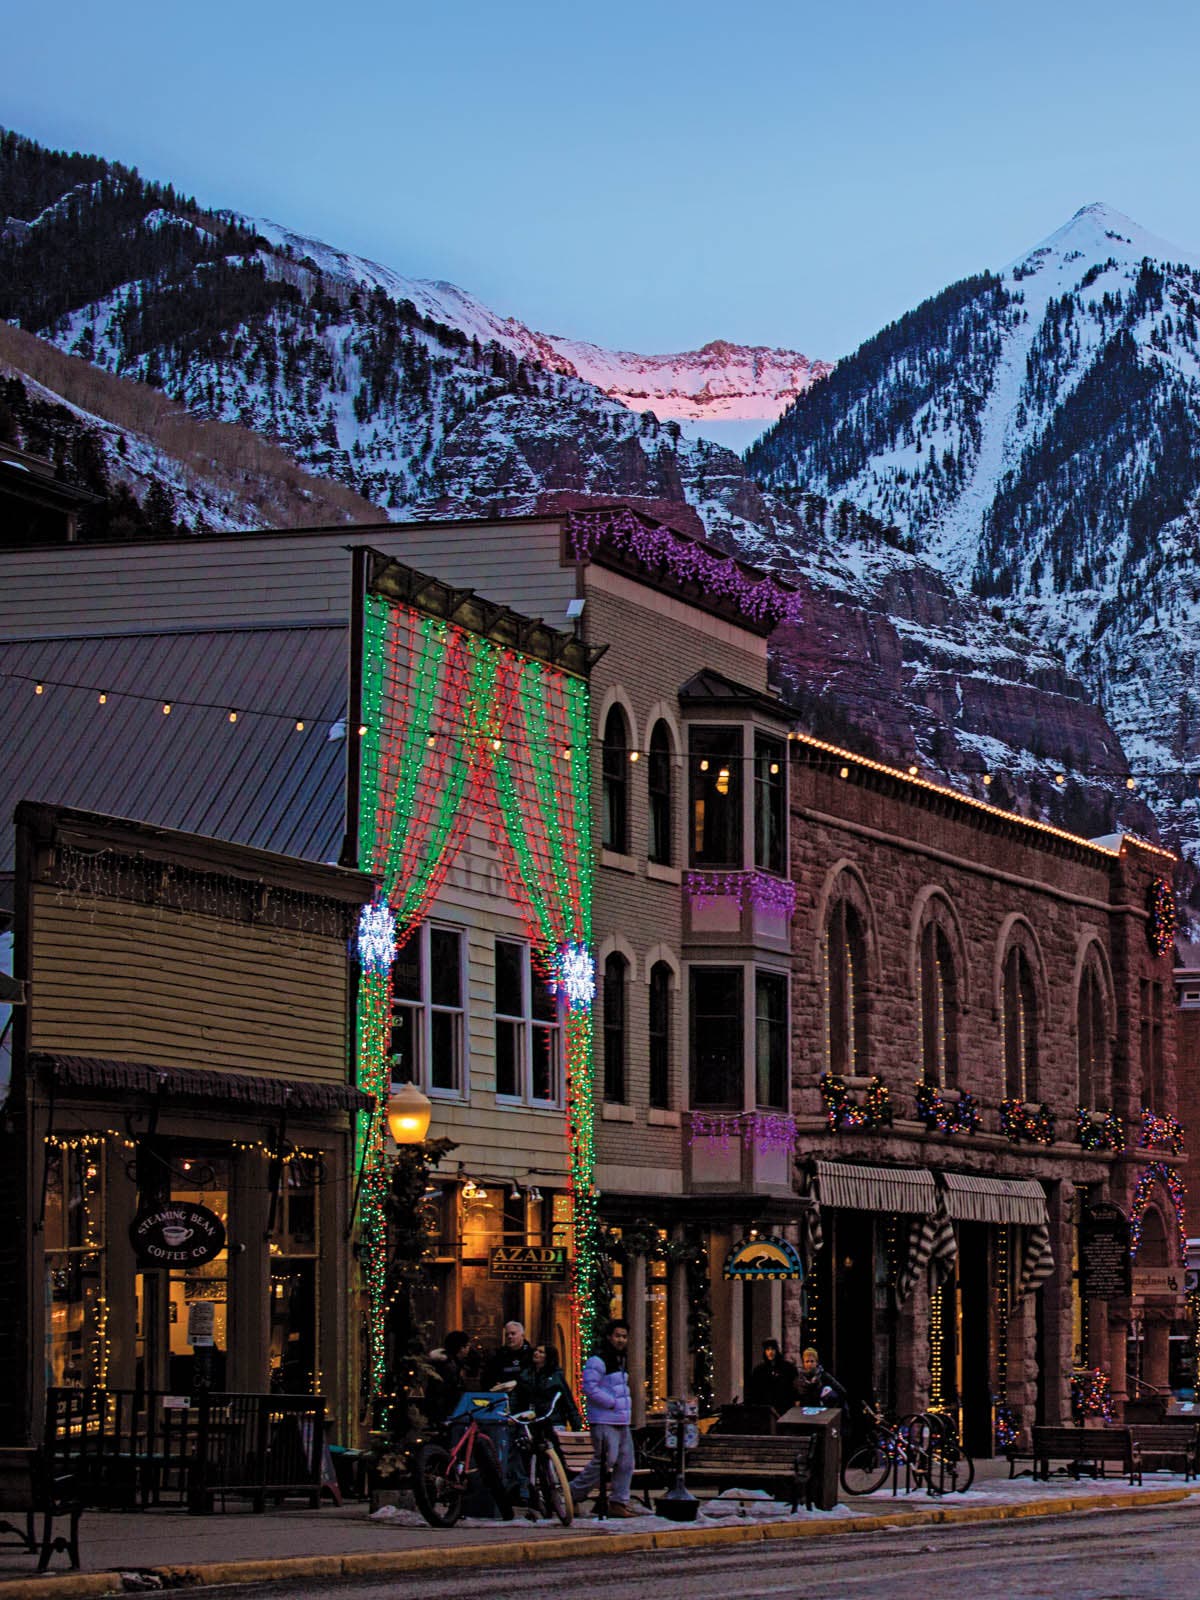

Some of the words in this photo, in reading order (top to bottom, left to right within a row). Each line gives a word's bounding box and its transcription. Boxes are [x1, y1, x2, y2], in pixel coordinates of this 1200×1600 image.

[138, 1210, 187, 1235] STEAMING
[190, 1213, 216, 1236] BEAN
[147, 1244, 189, 1260] COFFEE
[493, 1248, 564, 1263] AZADI
